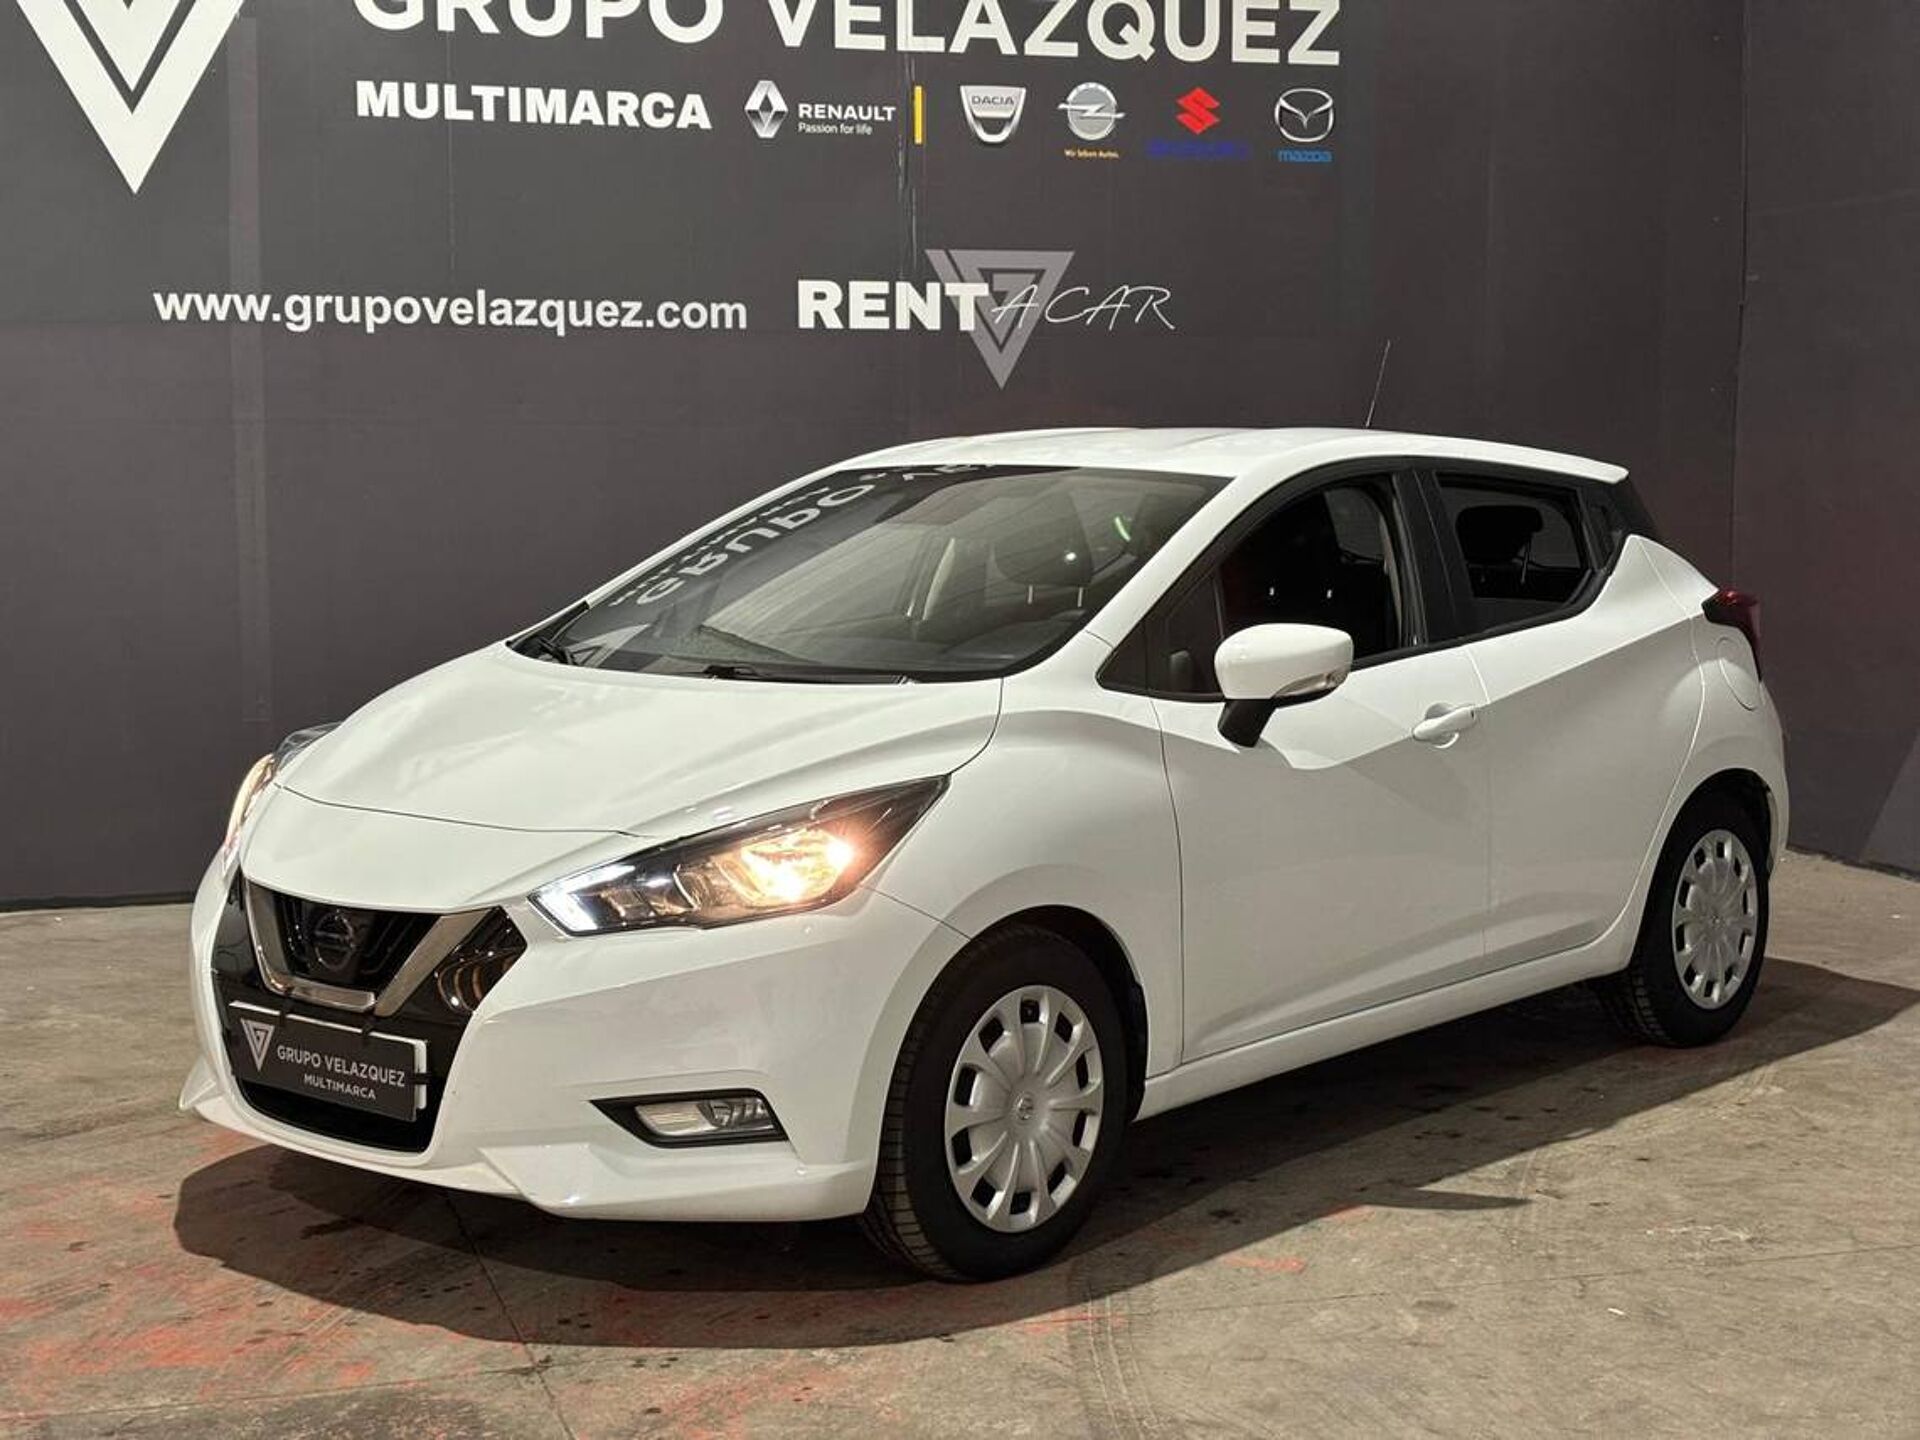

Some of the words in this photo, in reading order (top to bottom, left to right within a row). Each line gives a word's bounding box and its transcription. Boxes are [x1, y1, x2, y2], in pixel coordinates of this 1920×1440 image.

[767, 0, 1340, 66] VELAZQUEZ
[356, 80, 713, 130] MULTIMARCA
[798, 103, 897, 122] RENAULT
[971, 95, 1015, 106] DACIA
[798, 122, 838, 134] Passion
[840, 123, 854, 134] for
[856, 123, 873, 135] life
[152, 288, 747, 337] www.grupovelazquez.com
[797, 280, 990, 332] RENT
[276, 1045, 322, 1067] GRUPO
[324, 1055, 405, 1088] VELAZQUEZ
[303, 1073, 376, 1100] MULTIMARCA
